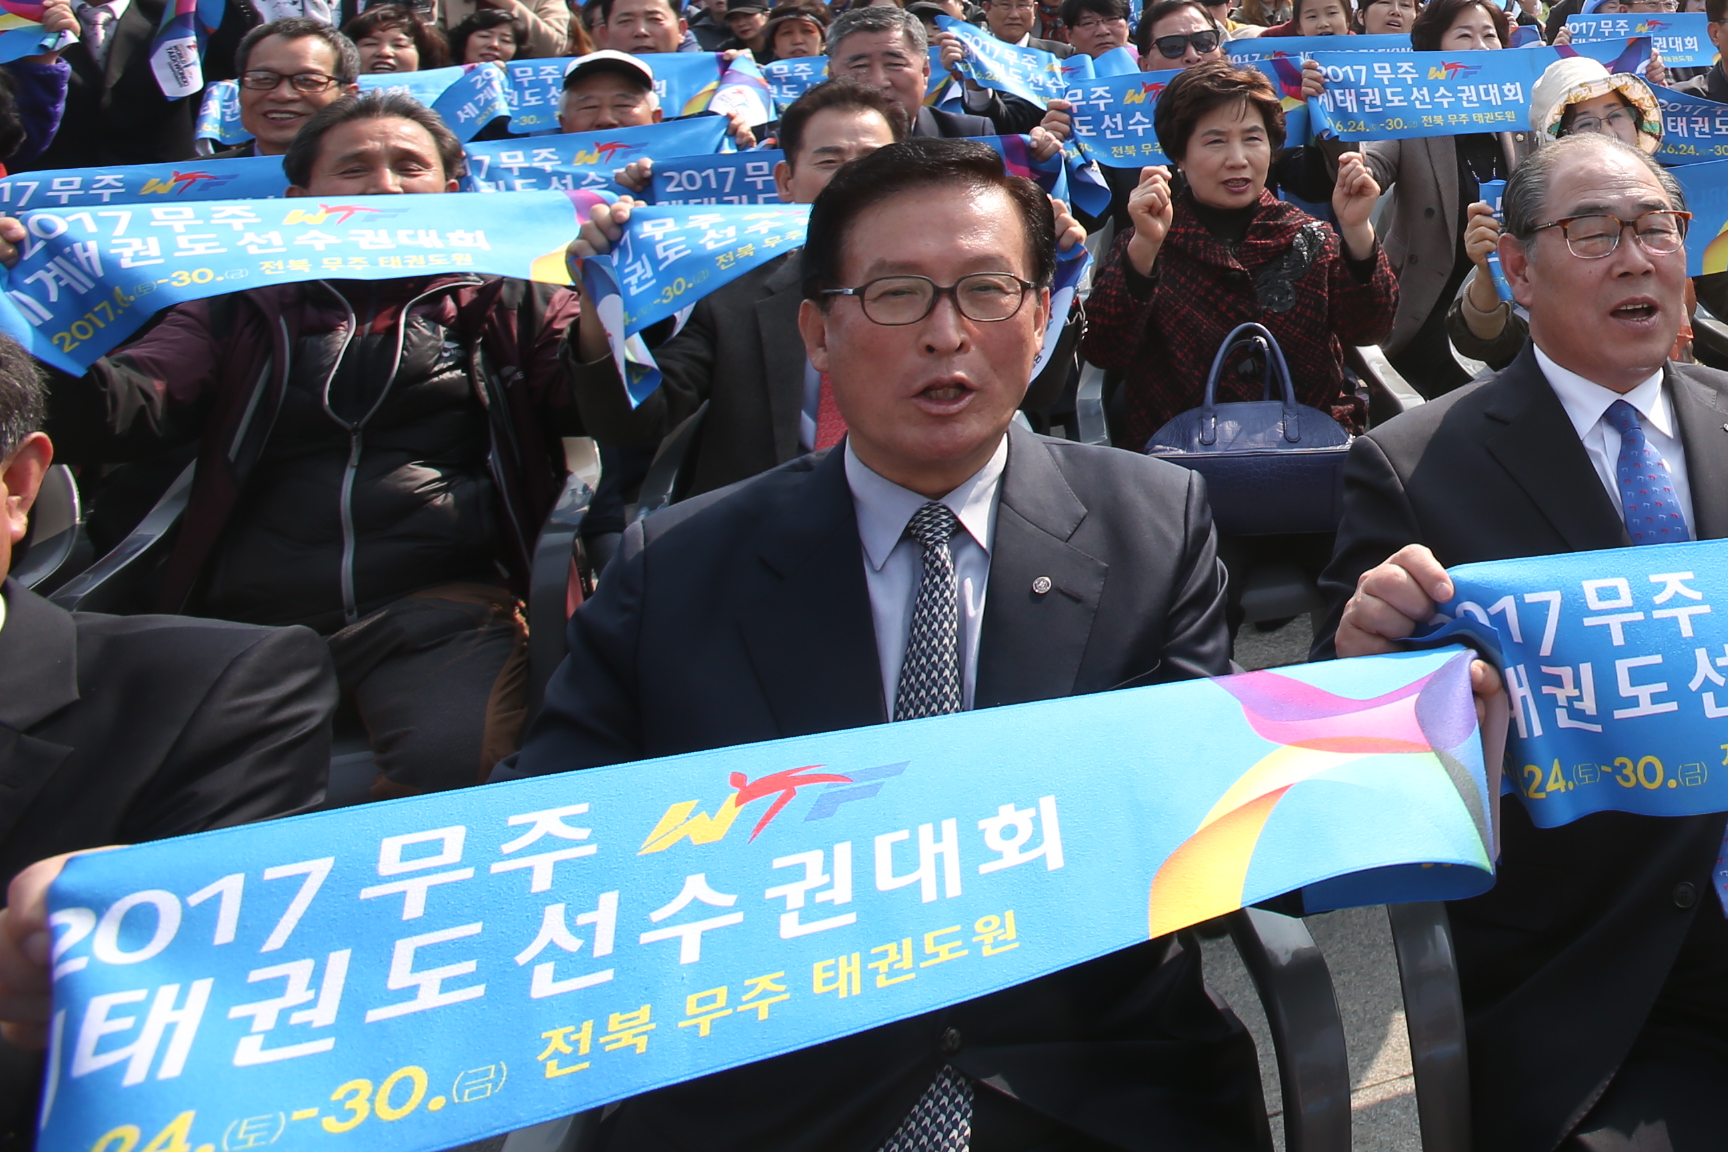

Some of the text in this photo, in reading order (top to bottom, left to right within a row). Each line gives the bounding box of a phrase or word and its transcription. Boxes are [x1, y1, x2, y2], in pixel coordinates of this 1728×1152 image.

[1565, 19, 1630, 37] 2017 무주
[963, 31, 1038, 71] 2017 무주
[1653, 36, 1698, 53] 권대회
[514, 65, 562, 86] 무주
[773, 62, 813, 83] 무주
[1317, 64, 1367, 86] 2017
[1373, 62, 1419, 86] 무주
[1065, 85, 1114, 114] 무주
[1659, 98, 1709, 114] 2017
[1421, 114, 1445, 128] 전북
[1447, 113, 1470, 126] 무주
[1472, 110, 1517, 124] 태권도원
[500, 148, 562, 176] 무주
[1111, 145, 1137, 159] 전북
[46, 174, 126, 204] 무주
[662, 161, 776, 195] 2017 무
[22, 210, 133, 261] 2017
[150, 205, 262, 236] 무주
[640, 214, 727, 243] 무주
[260, 253, 473, 276] 전북 무주 태권도원
[715, 230, 802, 272] 전북 무주
[1579, 570, 1712, 647] 무주
[50, 760, 911, 979] 2017 무주 WTF
[42, 795, 1066, 1128] 태권도선수권대회
[536, 1004, 657, 1079] 전북
[678, 970, 791, 1037] 무주
[812, 909, 1021, 1001] 태권도원
